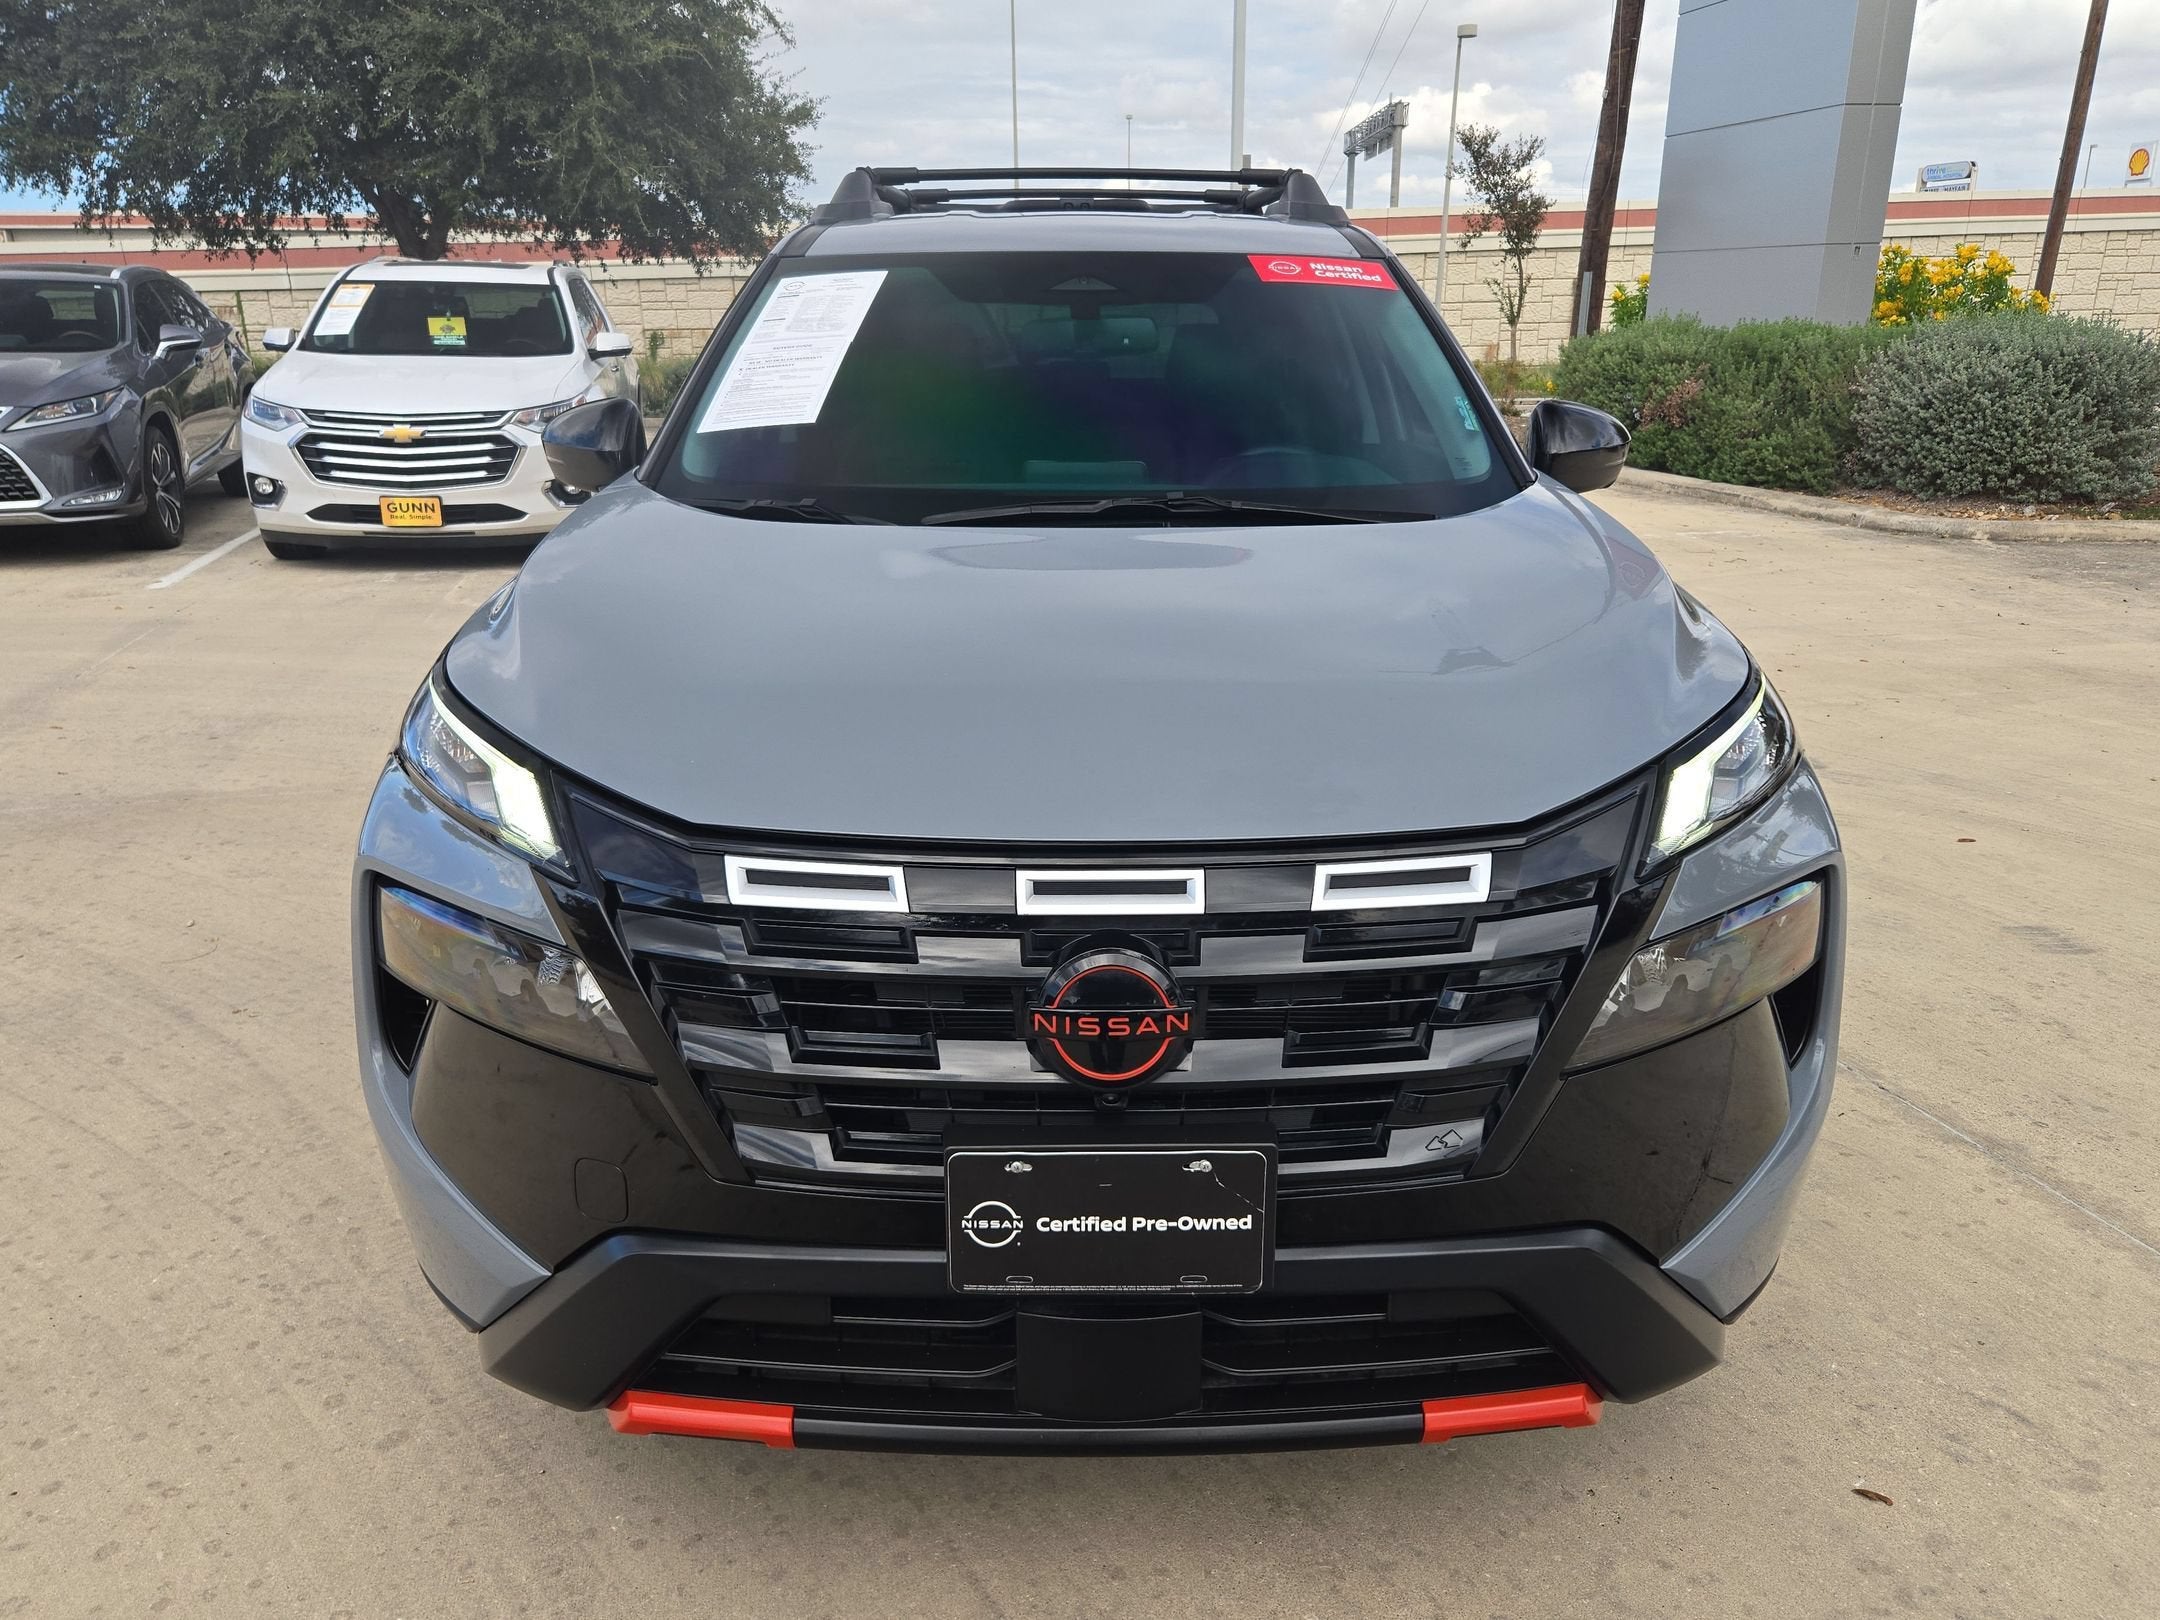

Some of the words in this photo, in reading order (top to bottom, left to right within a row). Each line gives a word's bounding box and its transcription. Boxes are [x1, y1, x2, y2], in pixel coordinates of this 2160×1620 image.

[1310, 262, 1363, 273] Nissan
[1315, 270, 1382, 282] Certified
[386, 502, 436, 513] GUNN
[1033, 1012, 1189, 1036] NISSAN
[961, 1219, 1024, 1229] NISSAN
[1036, 1216, 1127, 1232] Certified
[1132, 1214, 1252, 1231] Pre-Owned
